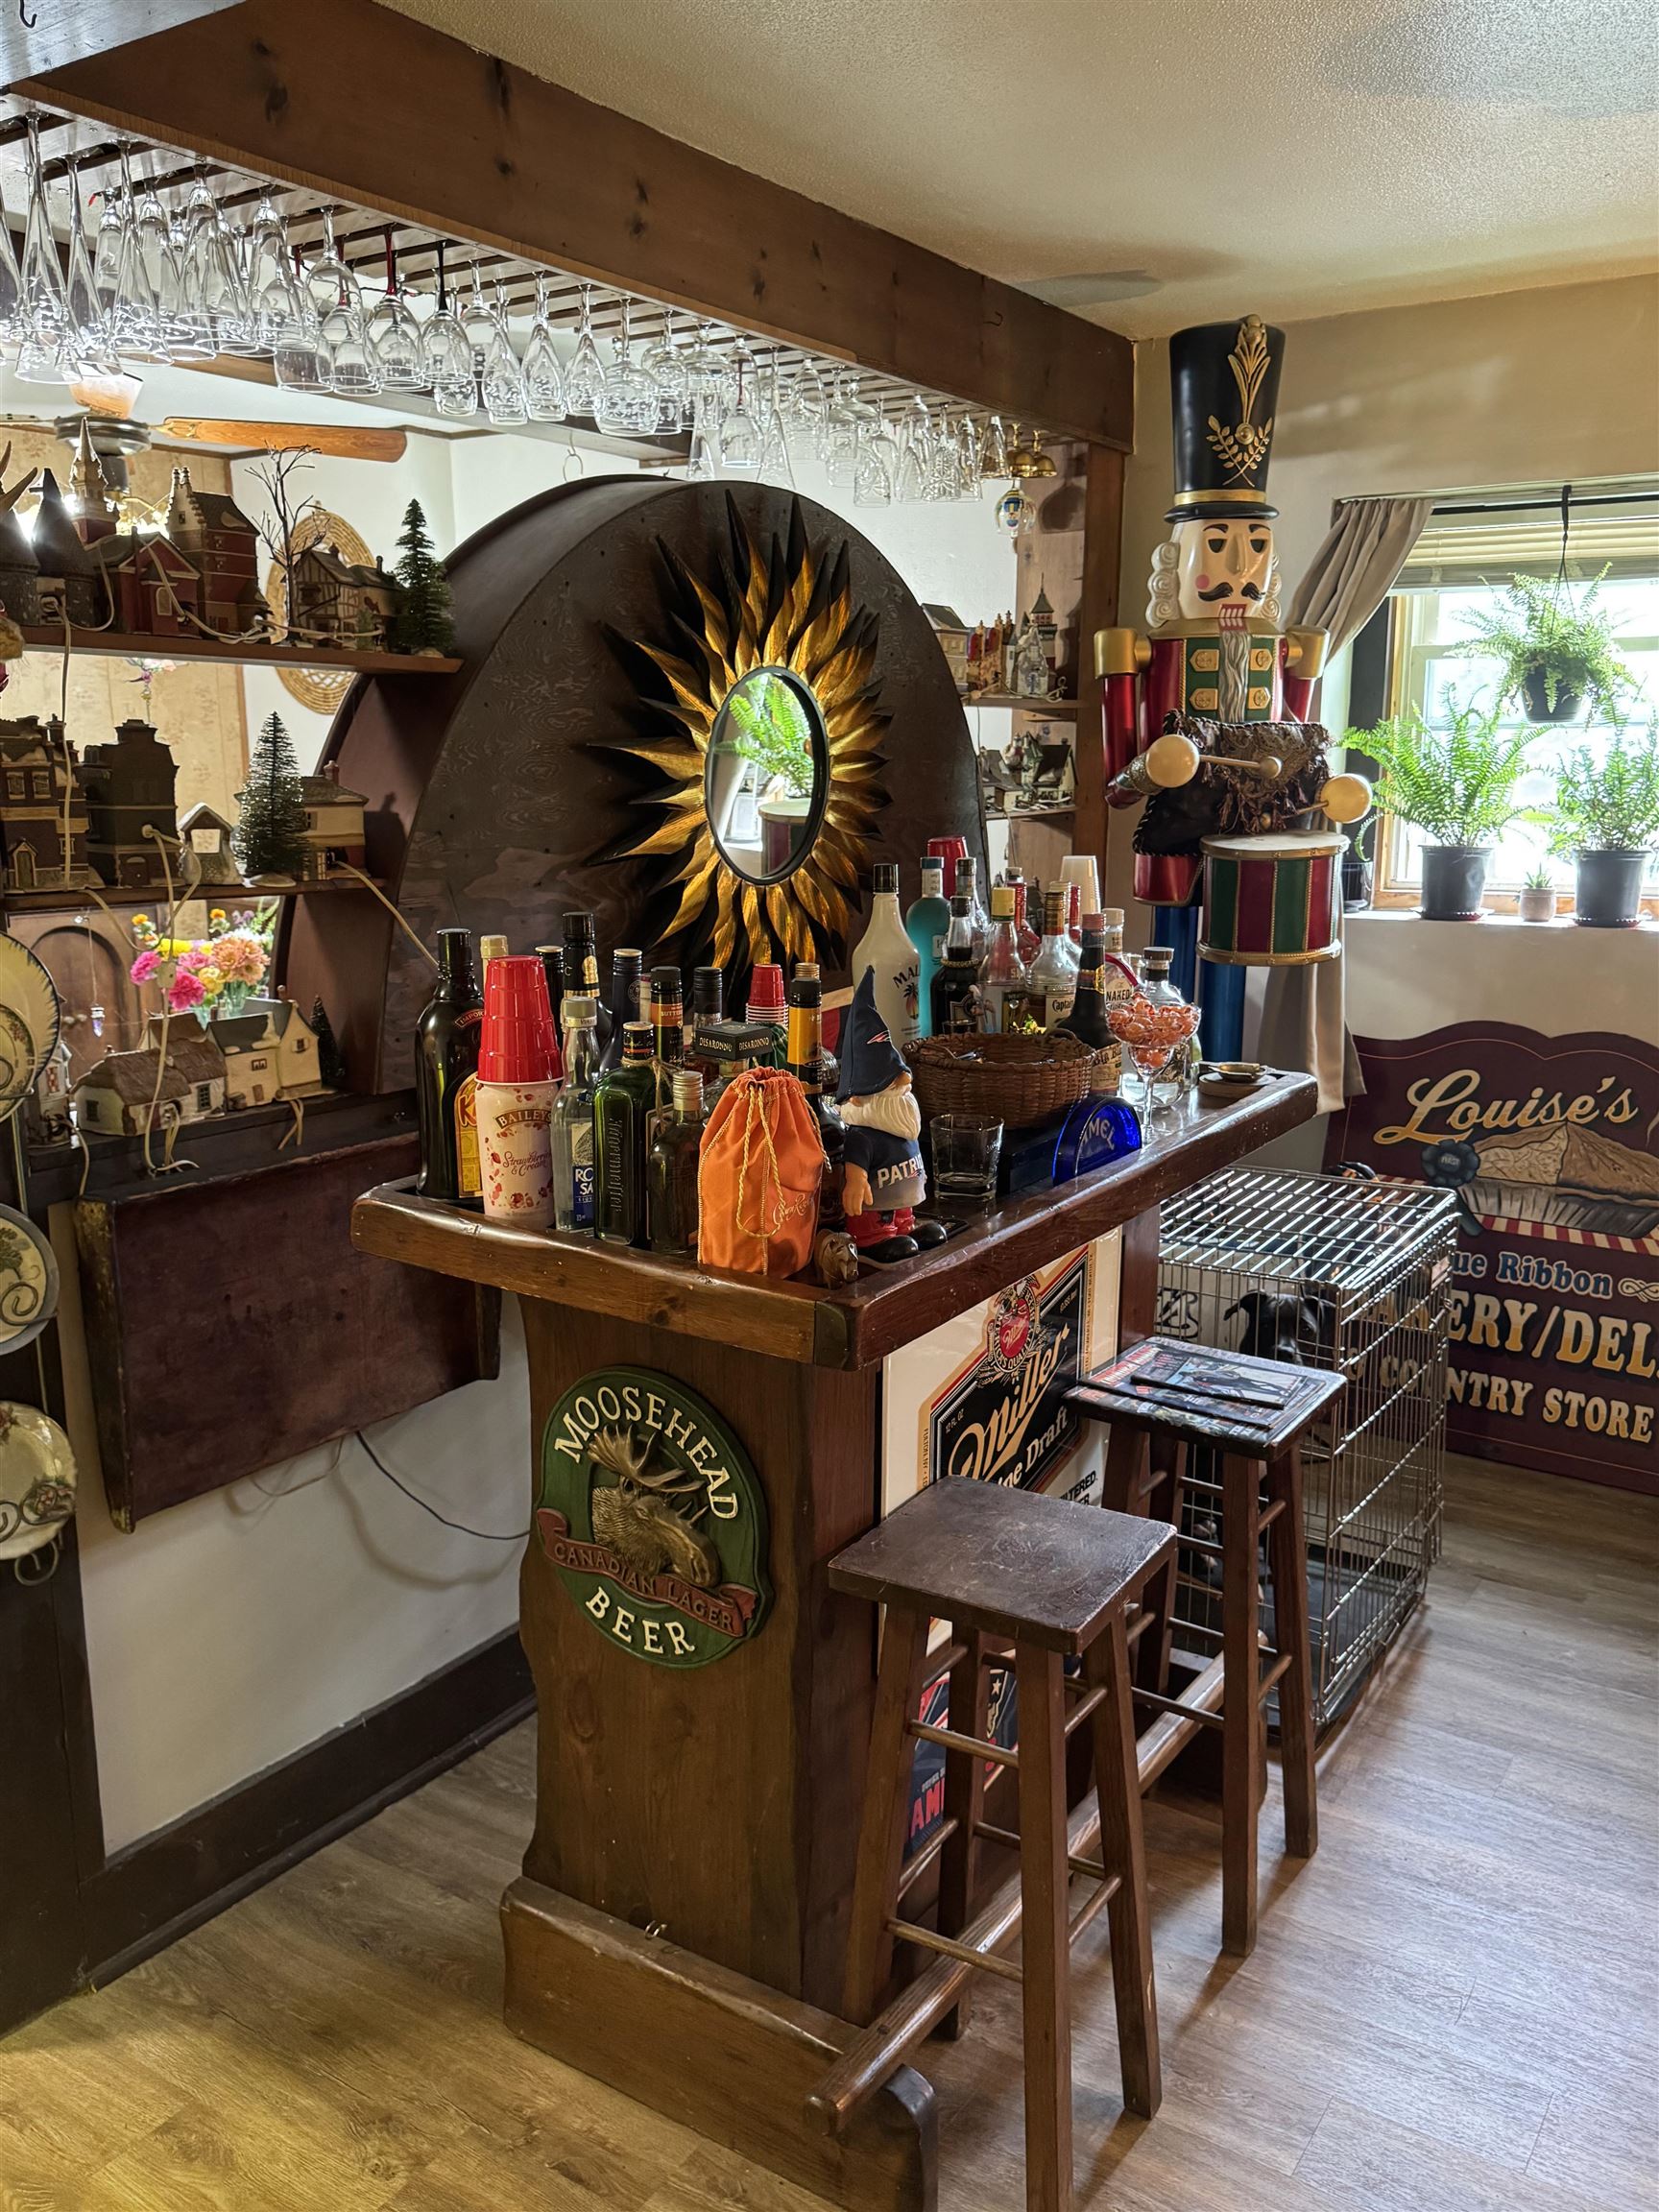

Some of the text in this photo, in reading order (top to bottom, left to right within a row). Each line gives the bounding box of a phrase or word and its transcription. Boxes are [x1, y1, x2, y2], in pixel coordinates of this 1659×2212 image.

[893, 965, 919, 988] MAL
[699, 1038, 733, 1052] DISARONNO
[738, 1037, 770, 1051] DISARONNO
[1374, 1069, 1638, 1145] Louise's
[1496, 1251, 1613, 1299] Ribbon
[949, 1323, 1070, 1481] Miller
[1542, 1387, 1655, 1443] STORE
[554, 1386, 738, 1520] MOOSEHEAD
[1025, 1406, 1069, 1473] Draft
[555, 1542, 734, 1631] CANADIAN LAGER
[586, 1586, 695, 1655] BEER
